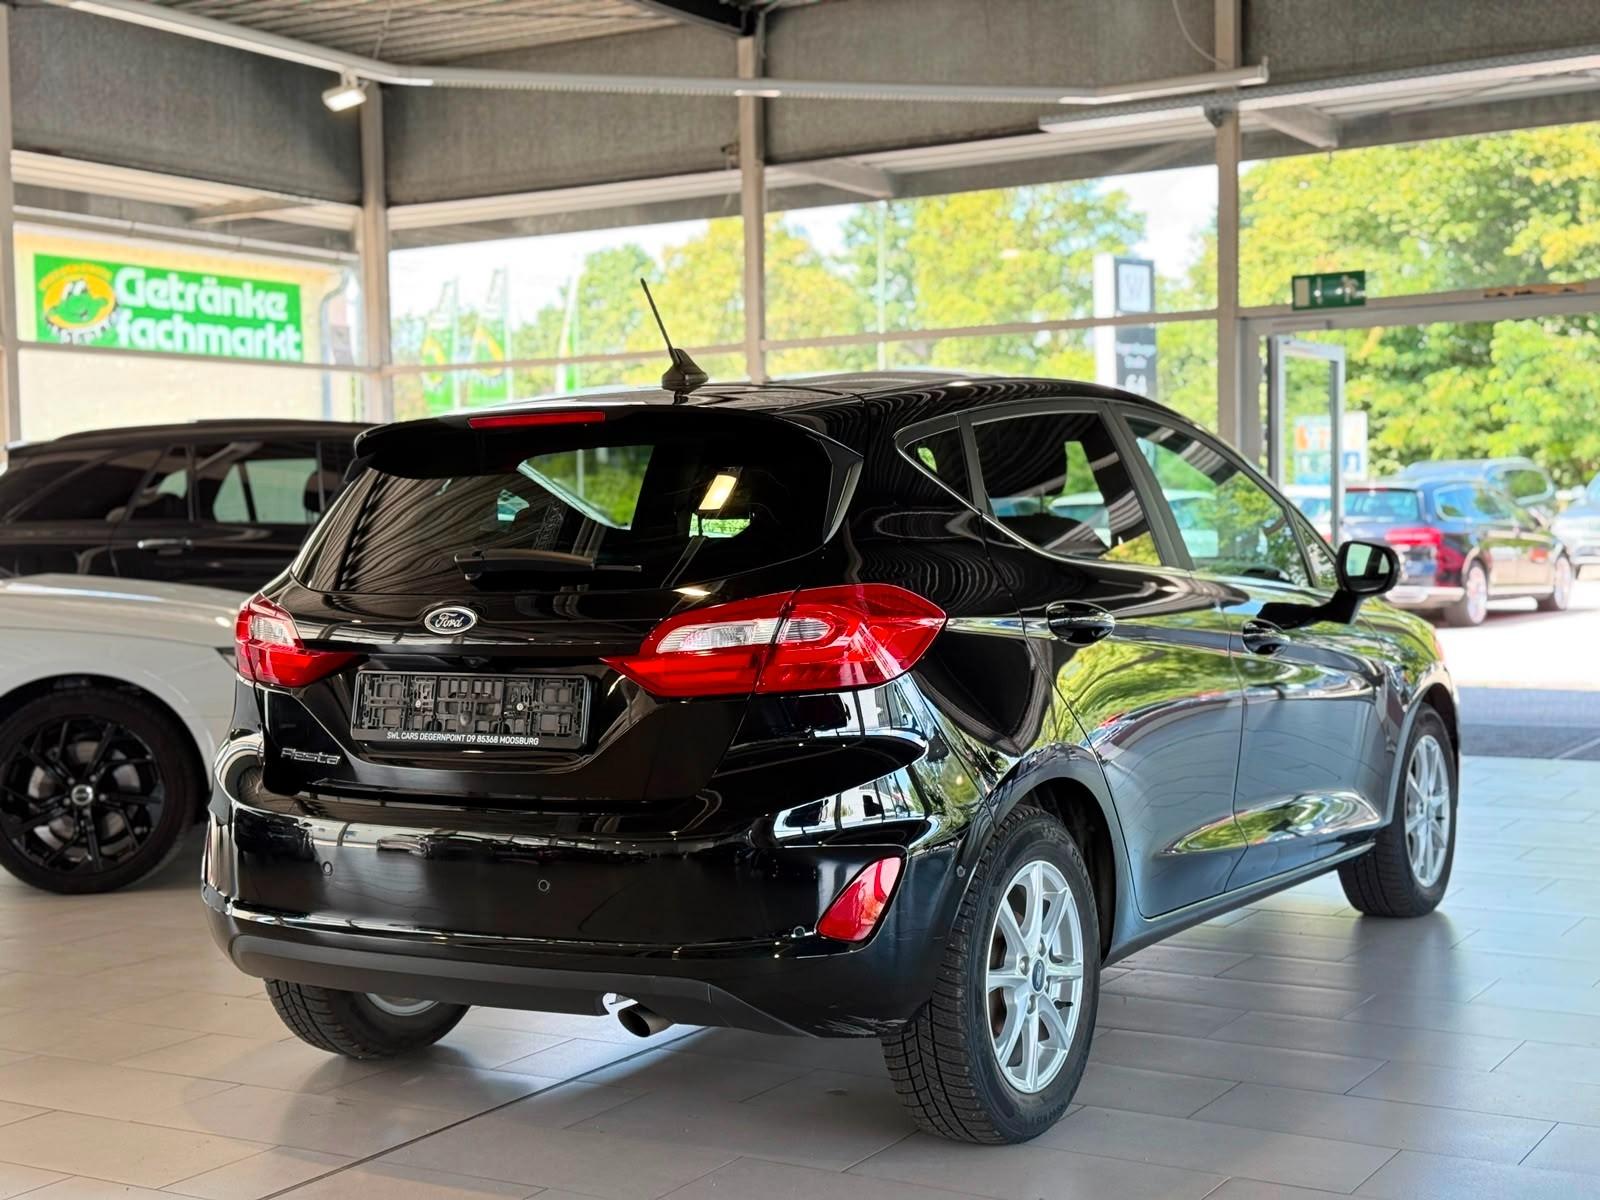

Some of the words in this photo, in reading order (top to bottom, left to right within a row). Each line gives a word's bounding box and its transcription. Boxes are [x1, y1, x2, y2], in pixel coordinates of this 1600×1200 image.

[114, 267, 288, 321] Getränke
[116, 309, 302, 361] fachmarkt
[434, 612, 465, 628] Ford
[387, 731, 400, 740] SWL
[401, 732, 419, 740] CARS
[419, 732, 466, 743] DEGERNPOINT
[476, 735, 499, 744] 85368
[499, 735, 539, 746] MOOSBURG
[281, 747, 340, 765] Fiesta
